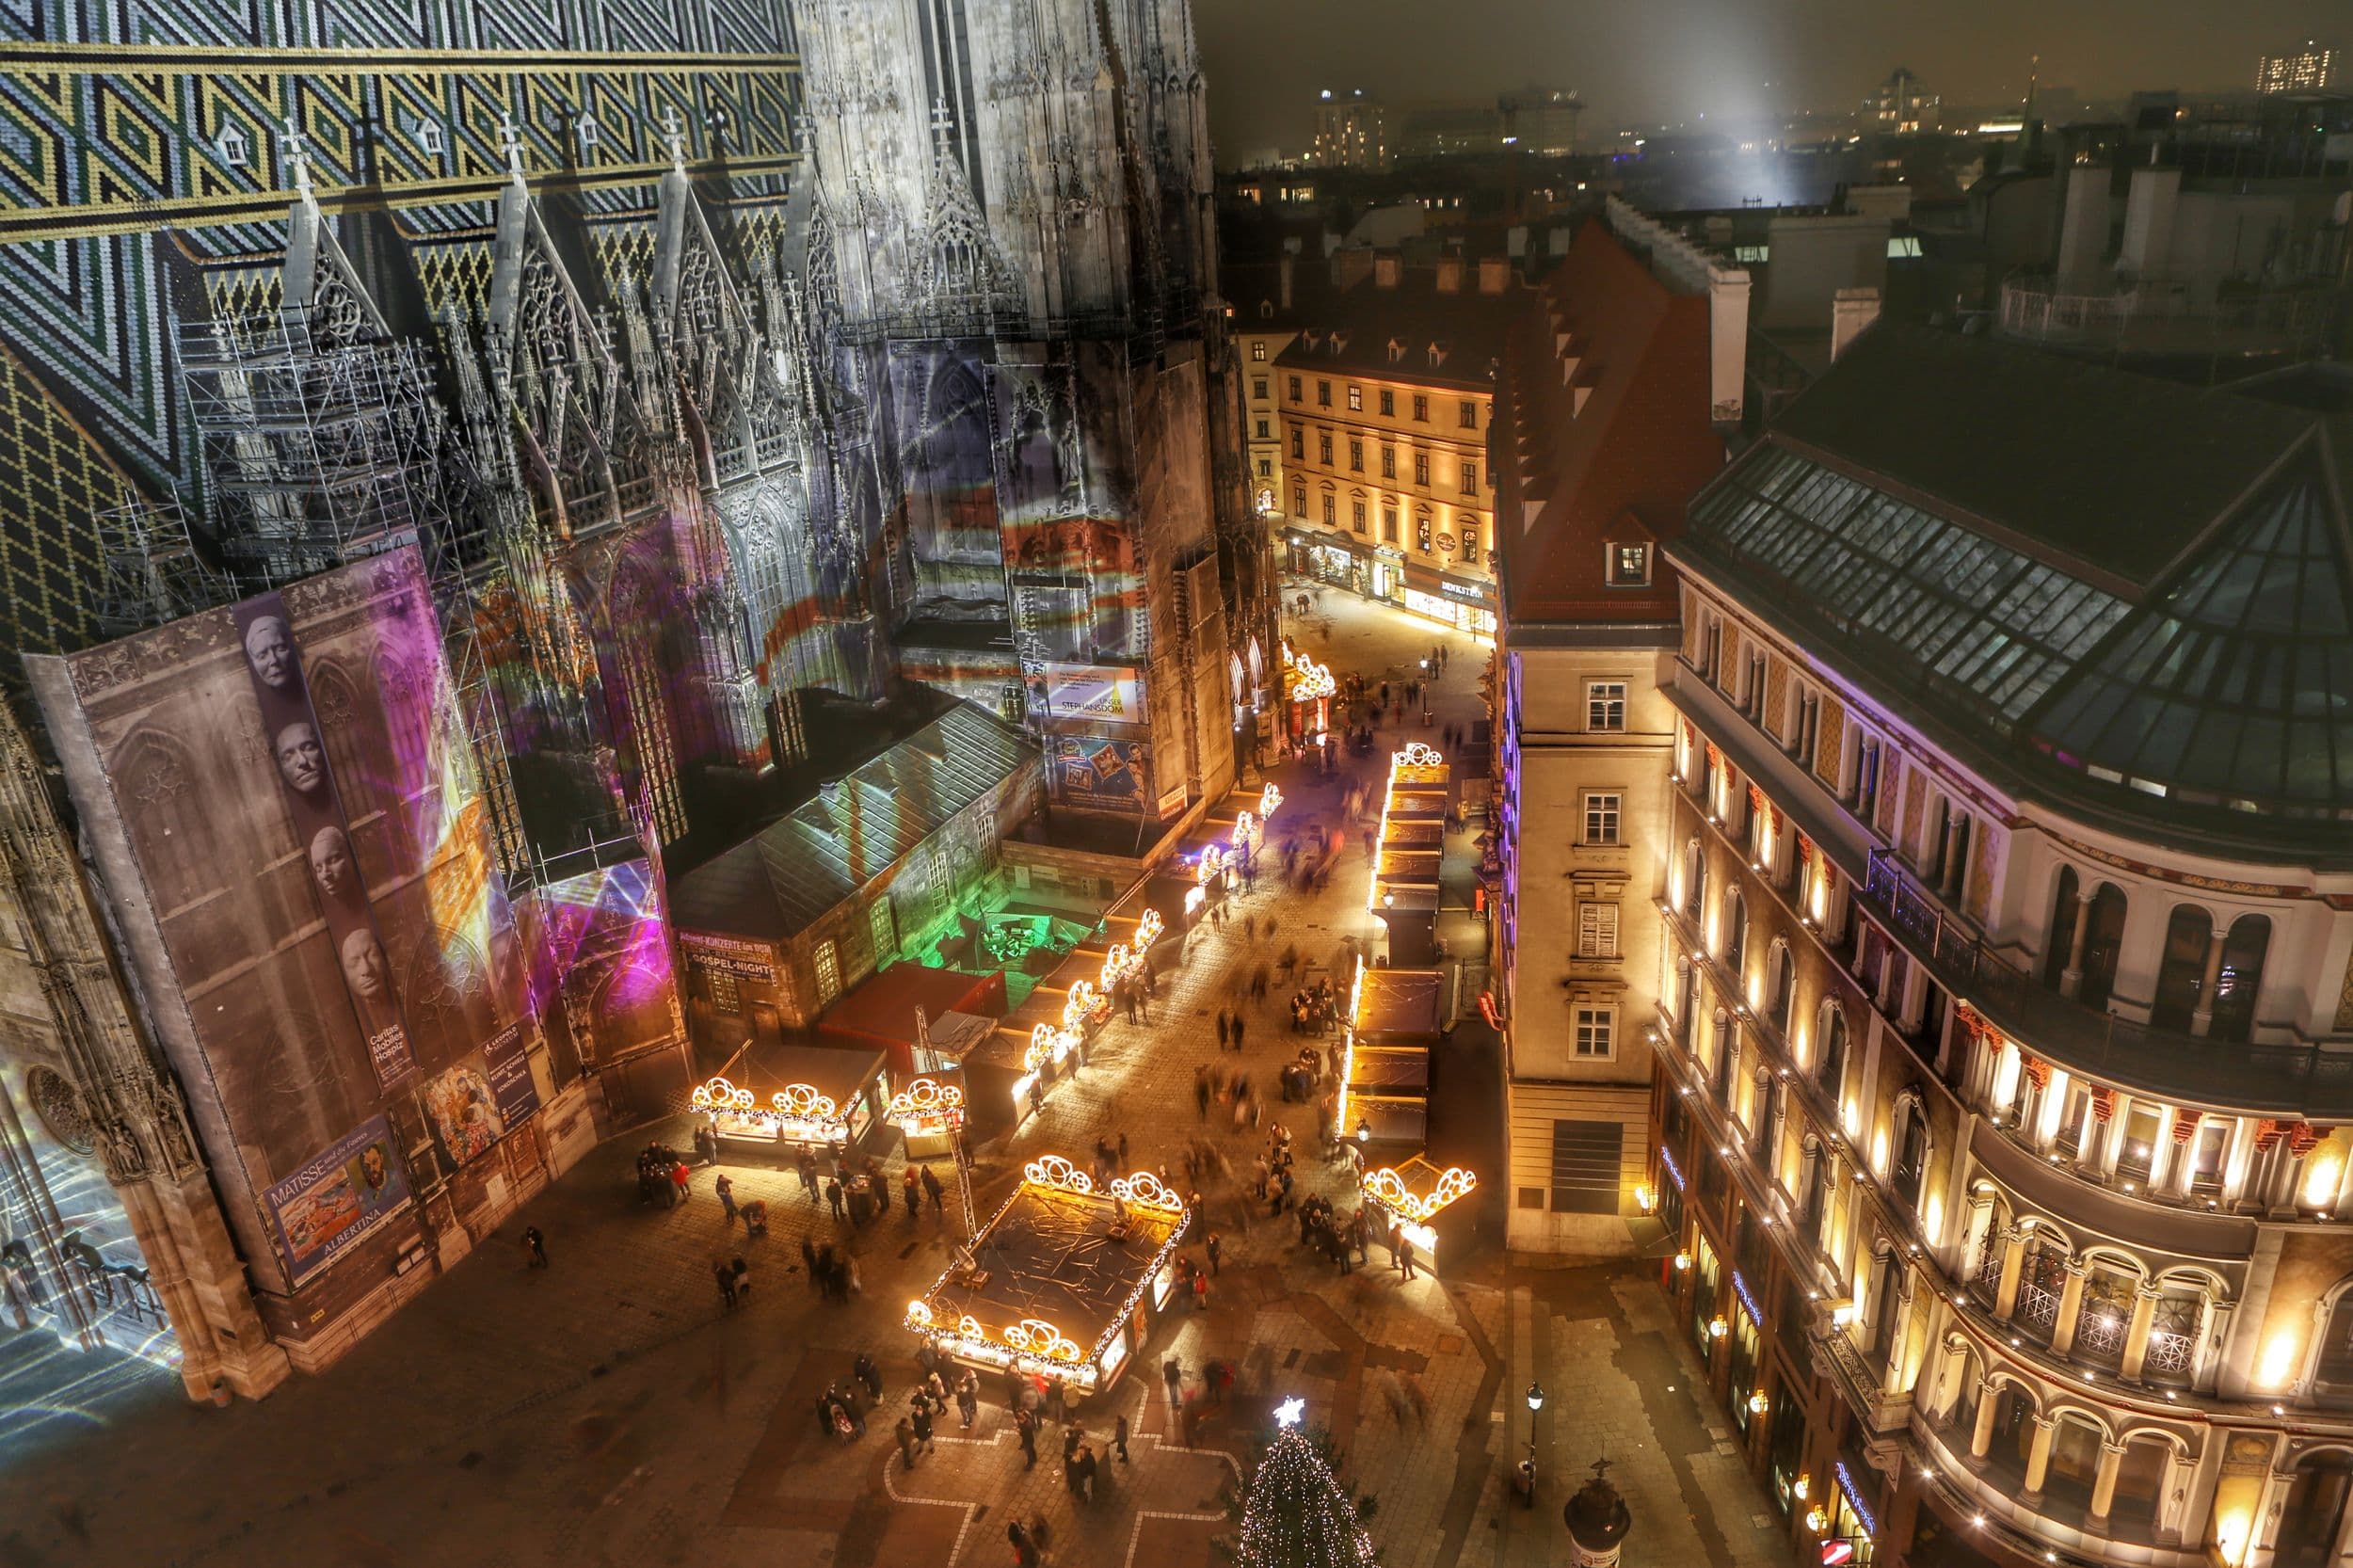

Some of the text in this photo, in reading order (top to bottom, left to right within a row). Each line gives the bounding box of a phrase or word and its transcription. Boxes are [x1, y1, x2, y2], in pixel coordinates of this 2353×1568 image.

[1062, 700, 1124, 713] STEPHANSDOM
[1099, 697, 1122, 706] UNSER
[370, 1024, 399, 1045] Caritas
[373, 1032, 405, 1054] Mobiles
[491, 1026, 518, 1046] LEOPOLD
[376, 1042, 404, 1064] Hospiz
[270, 1160, 327, 1207] MATISSE
[324, 1152, 338, 1165] und
[337, 1145, 346, 1157] die
[324, 1208, 381, 1255] ALBERTINA
